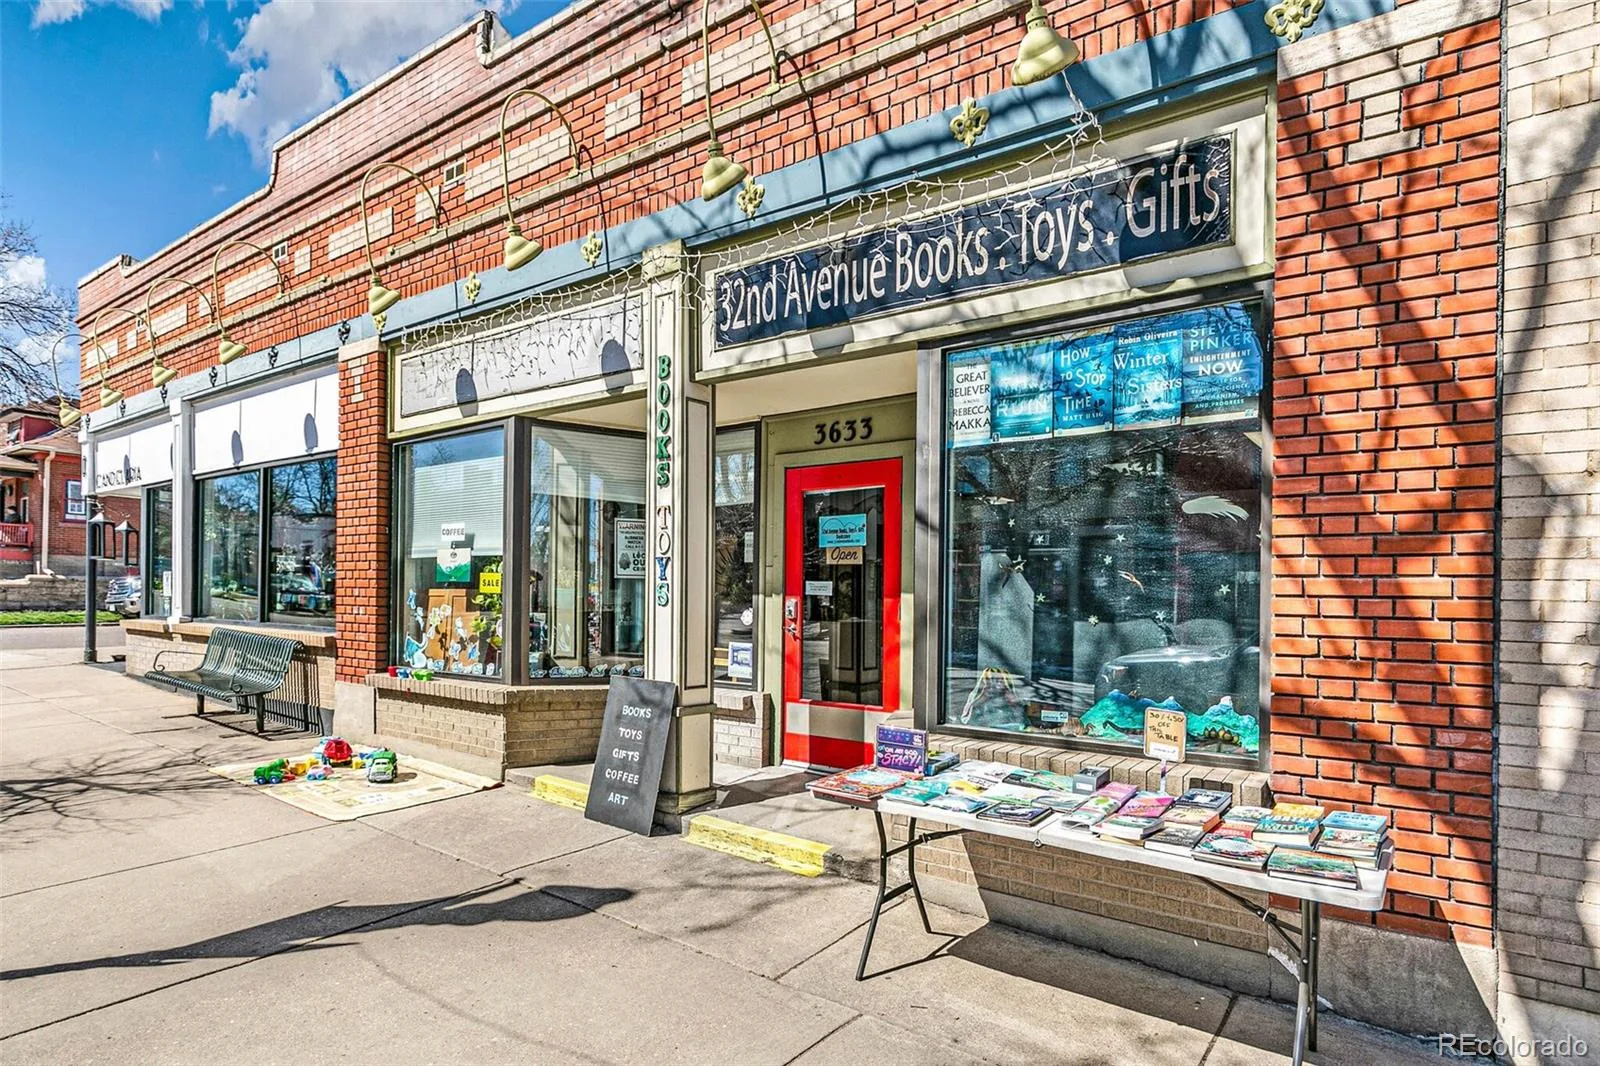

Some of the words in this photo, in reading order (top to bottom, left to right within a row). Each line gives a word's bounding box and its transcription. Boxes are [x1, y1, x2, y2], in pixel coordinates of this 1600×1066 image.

[719, 263, 777, 332] 32nd
[784, 254, 887, 318] Avenue
[896, 216, 989, 293] Books
[1014, 200, 1094, 271] Toys
[1126, 154, 1220, 238] Gifts
[1190, 318, 1252, 338] STEVEN
[1118, 336, 1141, 346] Robin
[1144, 329, 1178, 341] Oliveira
[1190, 333, 1252, 352] PINKER
[1113, 352, 1169, 371] Winter
[1190, 349, 1251, 364] ENLIGHTENMENT
[1198, 359, 1243, 376] NOW
[956, 371, 987, 384] GREAT
[949, 384, 990, 399] BELIEVER
[1127, 376, 1182, 395] Sisters
[953, 405, 991, 417] REBECCA
[813, 416, 873, 445] 3633
[442, 528, 465, 536] COFFEE
[831, 547, 858, 563] Open
[482, 579, 500, 587] SALE
[622, 705, 652, 719] BOOKS
[618, 727, 643, 741] TOYS
[1154, 732, 1179, 742] TABLE
[612, 748, 640, 762] GIFTS
[881, 752, 921, 768] STACY!
[605, 768, 639, 785] COFFEE
[607, 791, 629, 806] ART
